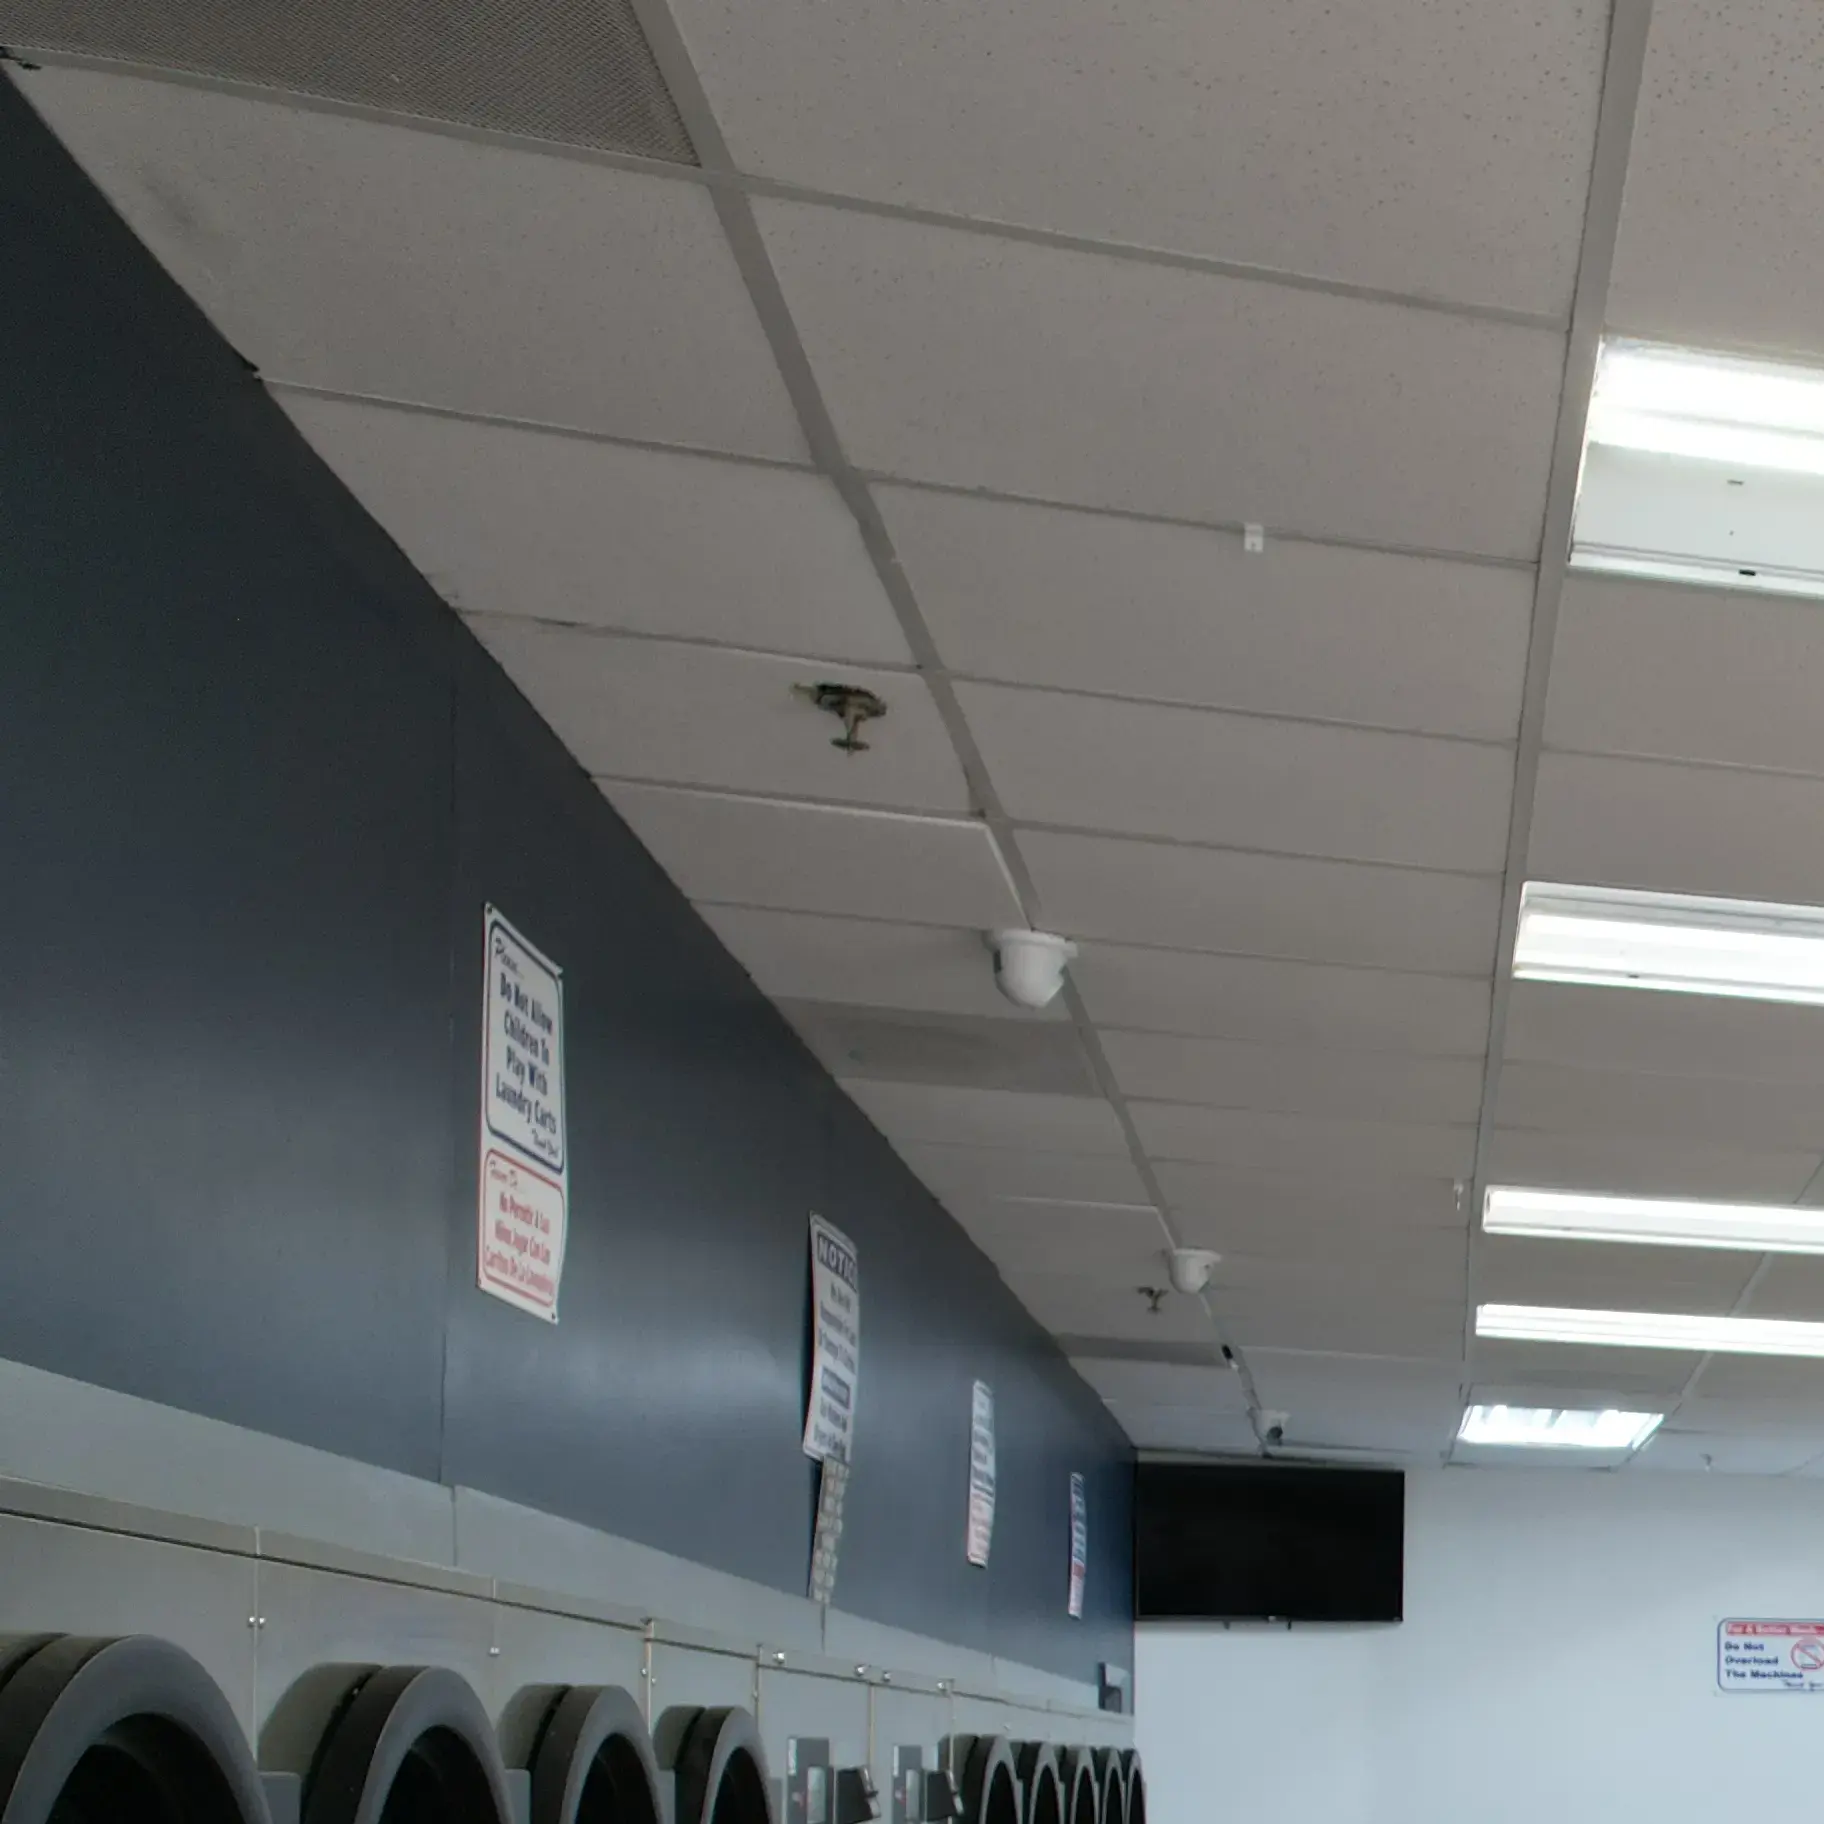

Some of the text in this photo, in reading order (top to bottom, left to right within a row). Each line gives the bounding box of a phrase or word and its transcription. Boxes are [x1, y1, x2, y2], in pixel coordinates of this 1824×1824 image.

[500, 972, 553, 1035] Do Not Allow
[504, 1009, 550, 1066] Children To
[506, 1045, 549, 1097] Play With
[496, 1072, 557, 1135] Laundry Carts
[1725, 1641, 1765, 1651] Do Not
[1725, 1655, 1779, 1665] Overload
[1726, 1669, 1804, 1679] The Machines
